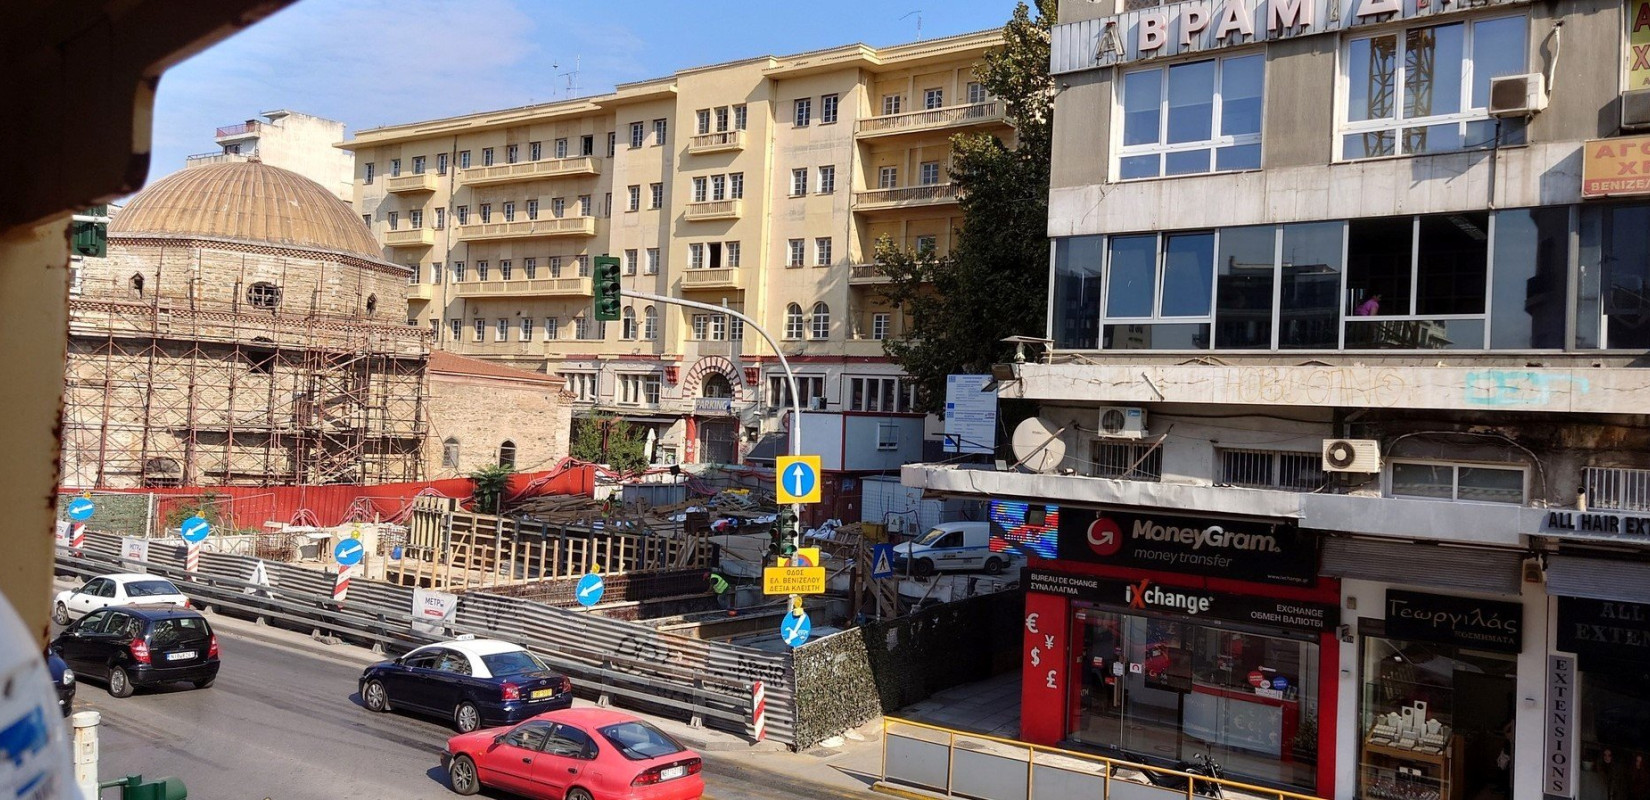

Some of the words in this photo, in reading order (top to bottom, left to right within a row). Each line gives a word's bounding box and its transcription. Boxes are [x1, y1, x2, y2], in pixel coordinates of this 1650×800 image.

[696, 401, 728, 409] PARKING
[1548, 511, 1575, 529] ALL
[1581, 513, 1619, 533] HAIR
[1625, 516, 1650, 534] EX
[1132, 519, 1277, 552] MoneyGram
[1134, 549, 1177, 564] money
[1179, 550, 1232, 567] transfer
[1031, 573, 1058, 584] BUREAU
[1058, 576, 1068, 585] DE
[1069, 577, 1098, 589] CHANGE
[1031, 582, 1078, 595] ΣΥΝΑΛΛΑΓΜΑ
[1250, 611, 1281, 622] ОБМЕН
[1277, 604, 1324, 617] EXCHANGE
[1390, 600, 1517, 633] Γεωργιλάς
[1552, 659, 1567, 792] EXTENSIONS
